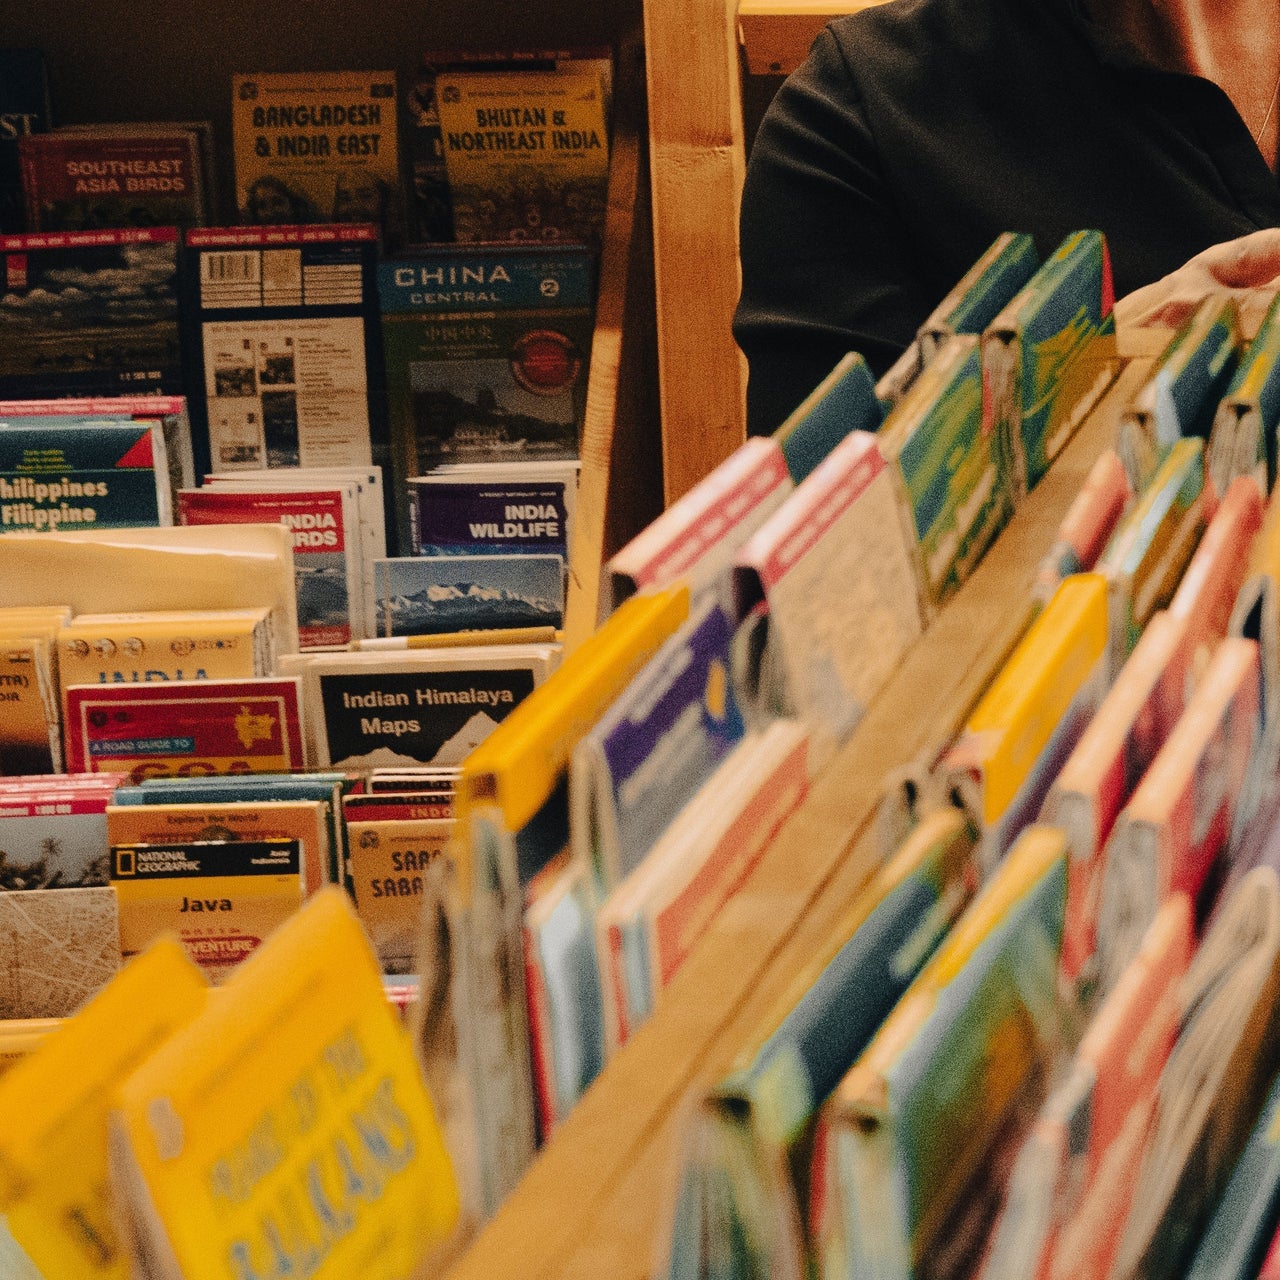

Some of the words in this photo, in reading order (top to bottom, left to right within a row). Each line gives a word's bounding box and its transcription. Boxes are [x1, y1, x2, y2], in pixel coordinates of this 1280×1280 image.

[252, 106, 381, 128] BANGLADESH
[475, 109, 545, 128] BHUTAN
[448, 130, 544, 152] NORTHEAST
[552, 130, 600, 150] INDIA
[66, 160, 181, 176] SOUTHEAST
[75, 178, 119, 193] ASIA
[126, 177, 185, 192] BIRDS
[394, 265, 510, 286] CHINA
[410, 290, 500, 305] CENTRAL
[505, 505, 558, 520] INDIA
[469, 521, 558, 538] WILDLIFE
[344, 690, 411, 708] Indian
[416, 688, 514, 708] Himalaya
[361, 718, 419, 735] Maps
[180, 896, 232, 912] Java
